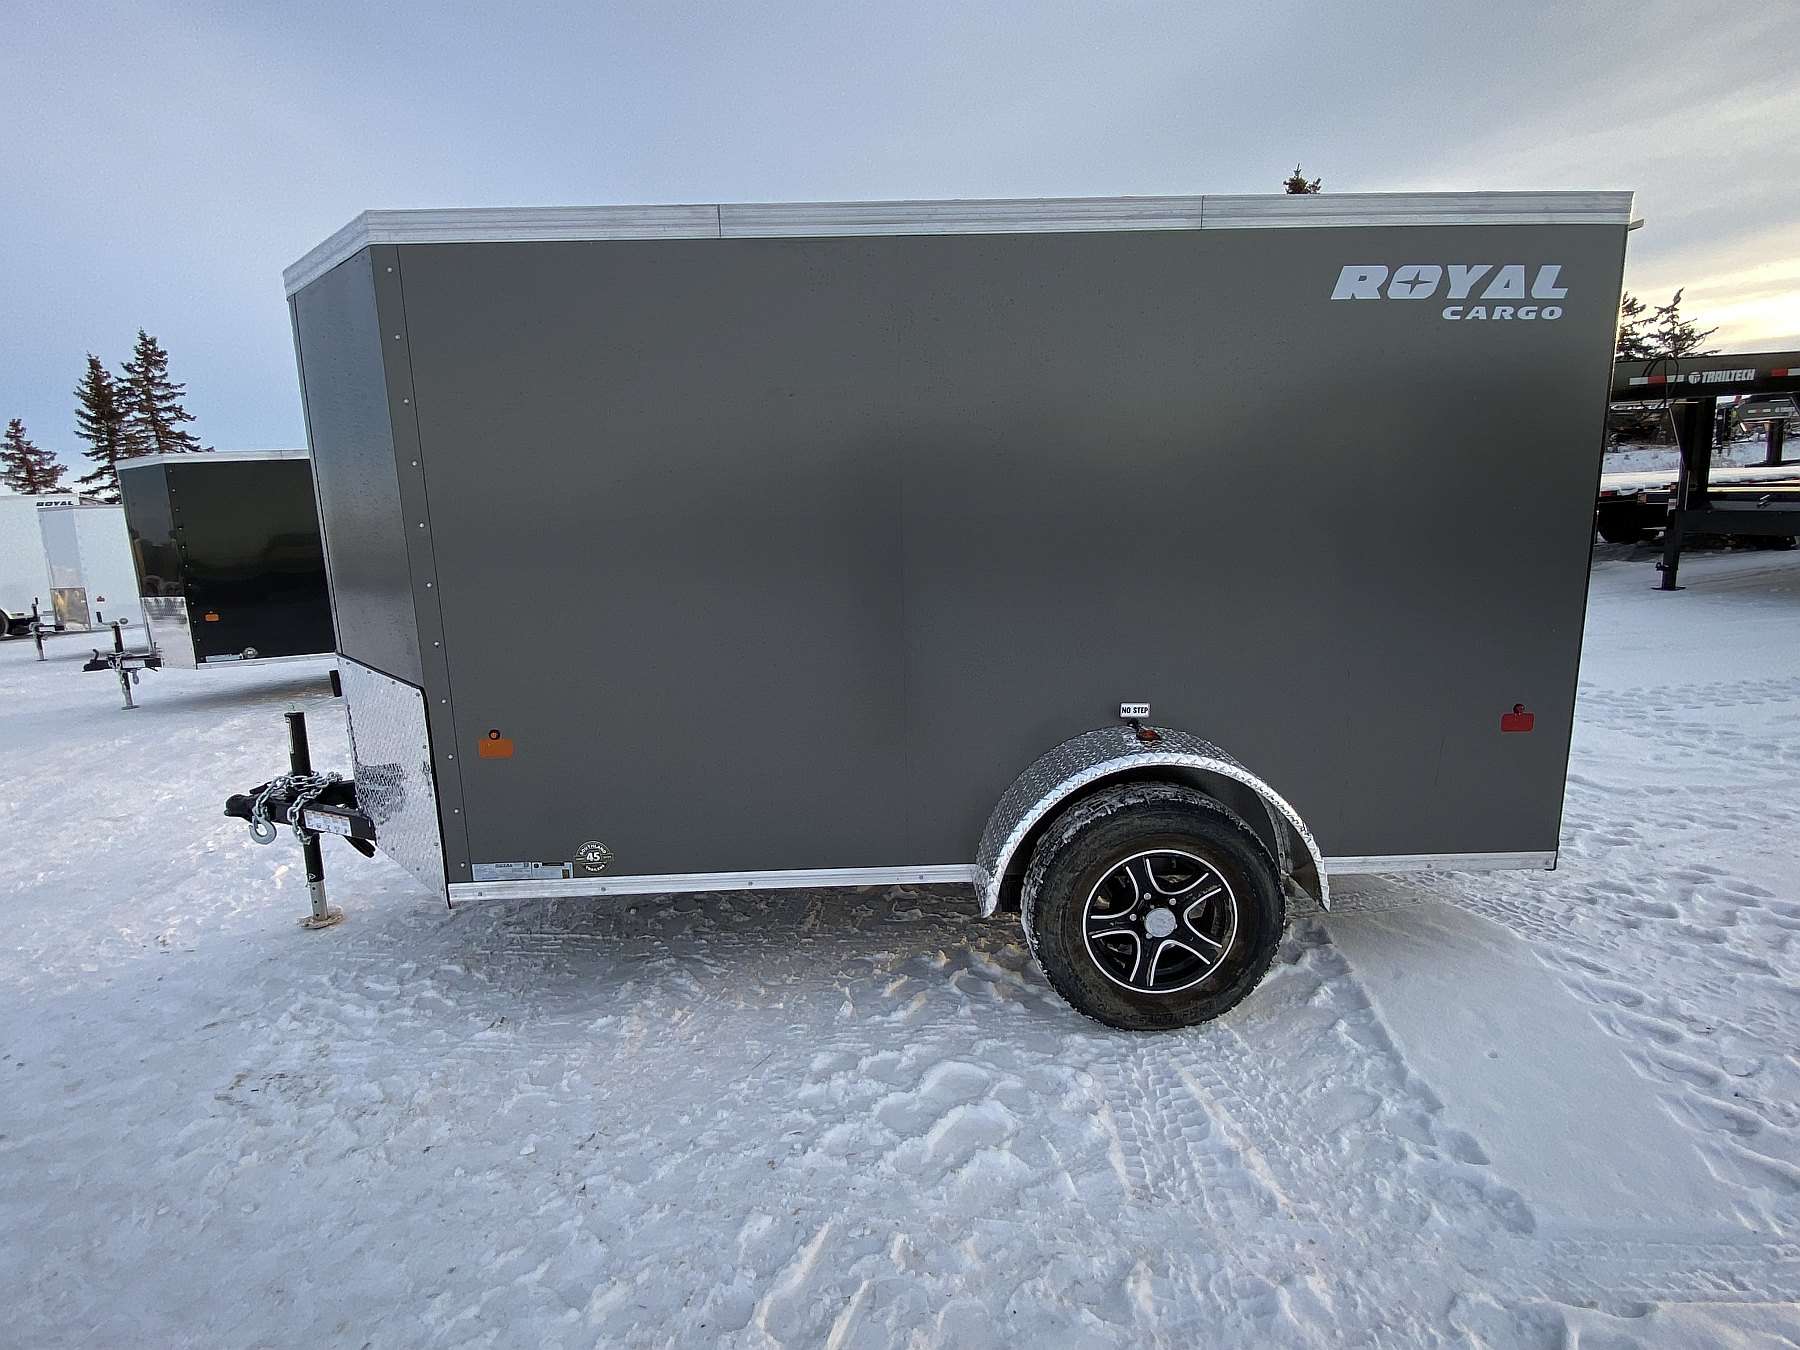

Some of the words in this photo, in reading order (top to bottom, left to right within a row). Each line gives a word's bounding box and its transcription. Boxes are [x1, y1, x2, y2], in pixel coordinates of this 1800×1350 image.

[1331, 265, 1569, 300] ROYAL
[1442, 306, 1563, 320] CARGO
[1702, 370, 1755, 383] TRAILTECH
[586, 852, 600, 861] 45
